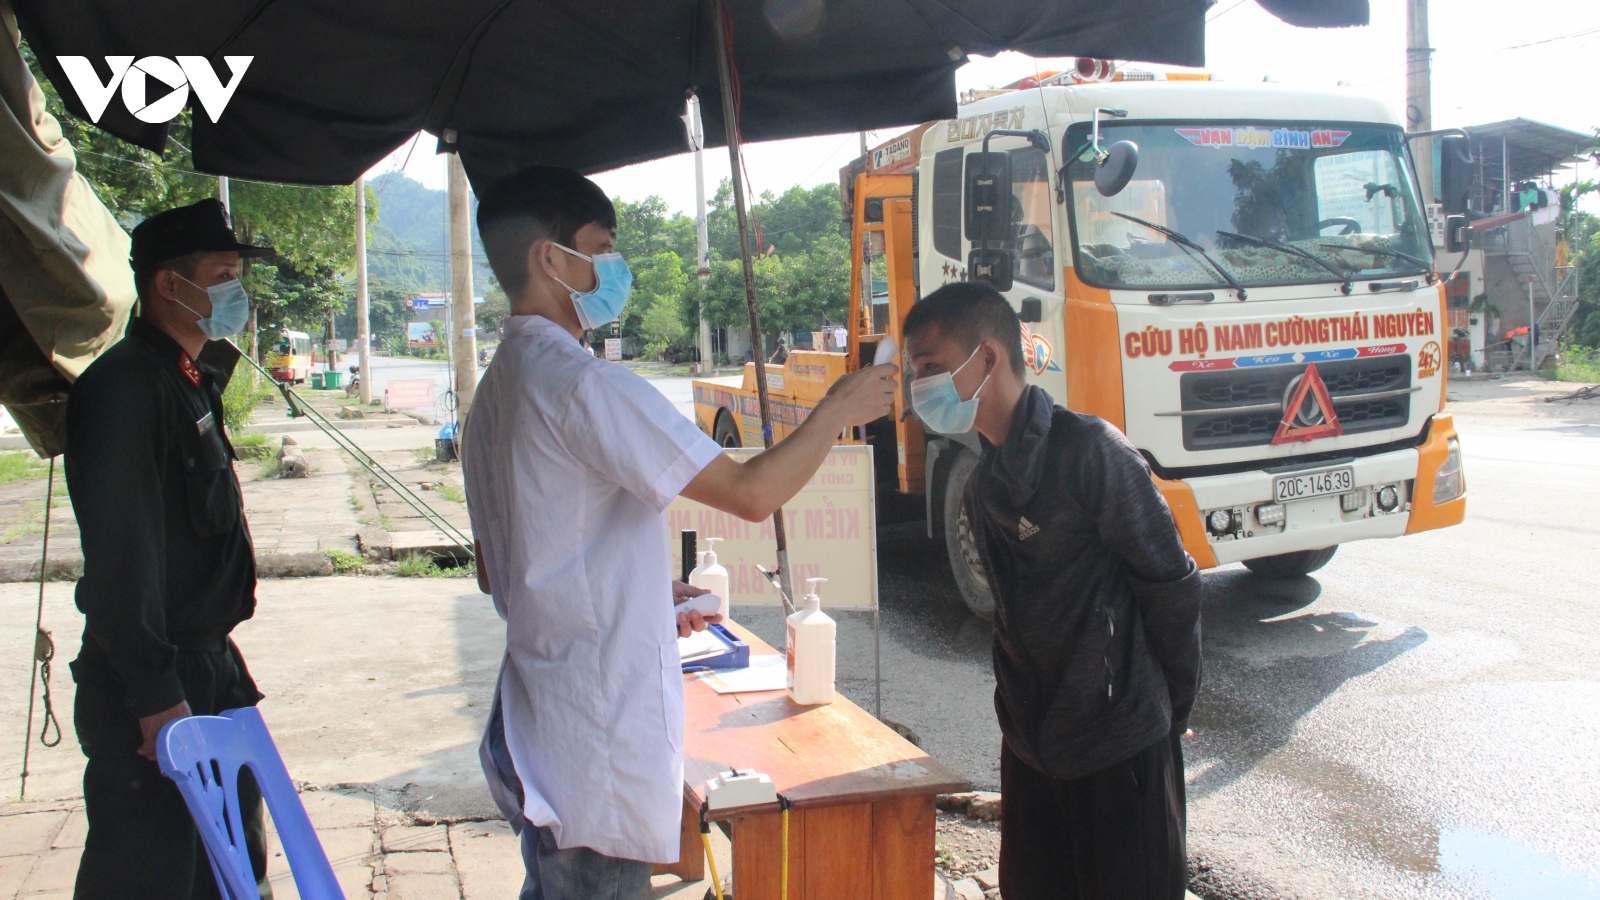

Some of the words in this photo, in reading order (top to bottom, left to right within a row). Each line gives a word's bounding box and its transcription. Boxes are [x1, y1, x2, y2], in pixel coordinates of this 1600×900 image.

[947, 106, 1025, 142] 현대자동차
[885, 138, 909, 155] TADANO
[1313, 130, 1332, 146] AN
[1125, 325, 1172, 359] CỨU
[1178, 321, 1209, 359] HỘ
[1214, 322, 1264, 352] NAM
[1373, 307, 1434, 339] NGUYÊN
[1418, 368, 1435, 379] SERVICE
